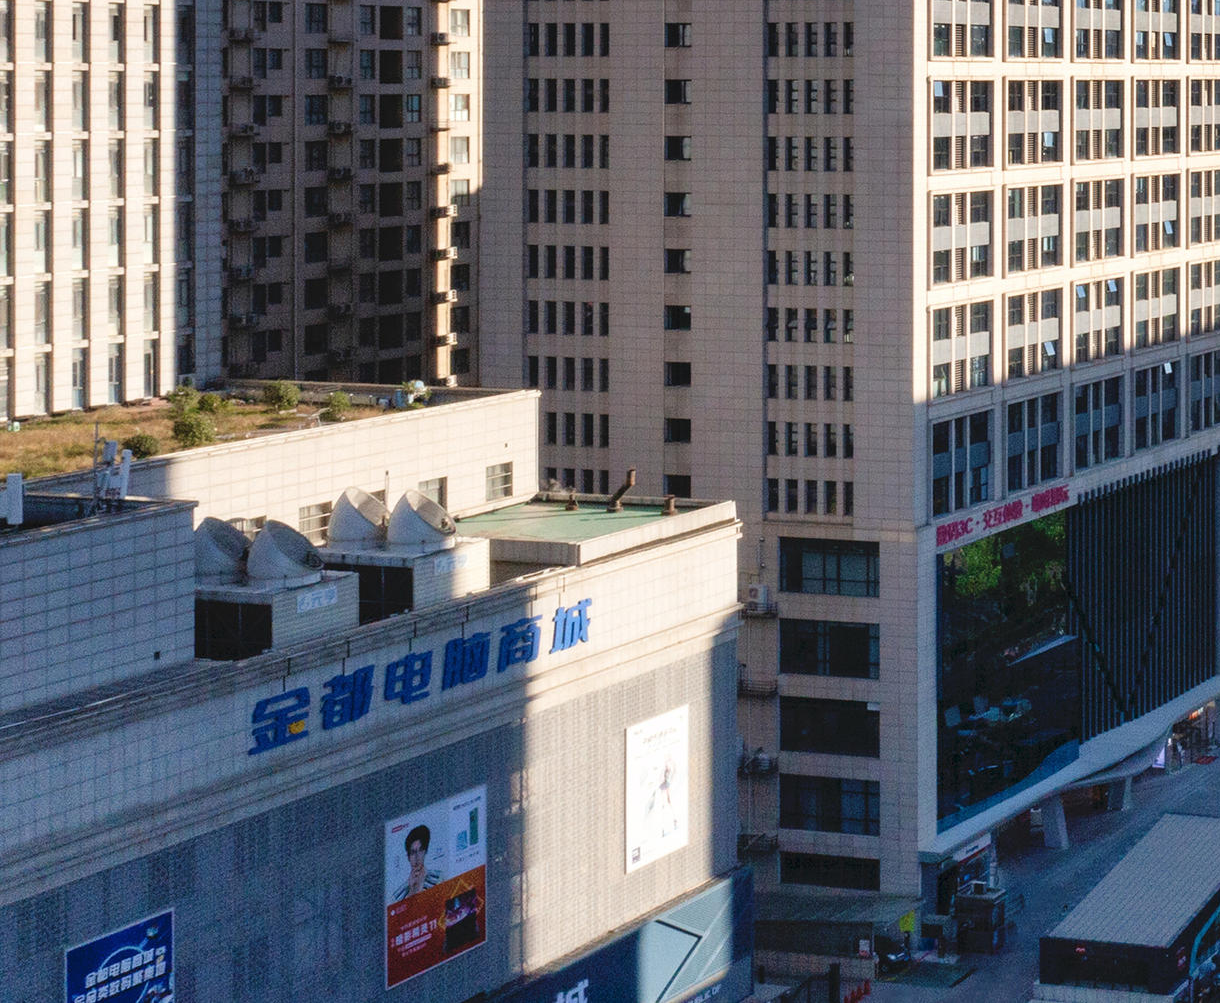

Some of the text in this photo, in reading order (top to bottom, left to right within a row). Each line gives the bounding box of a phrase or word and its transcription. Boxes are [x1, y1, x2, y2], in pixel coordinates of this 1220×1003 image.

[248, 598, 593, 756] 金都电脑商城
